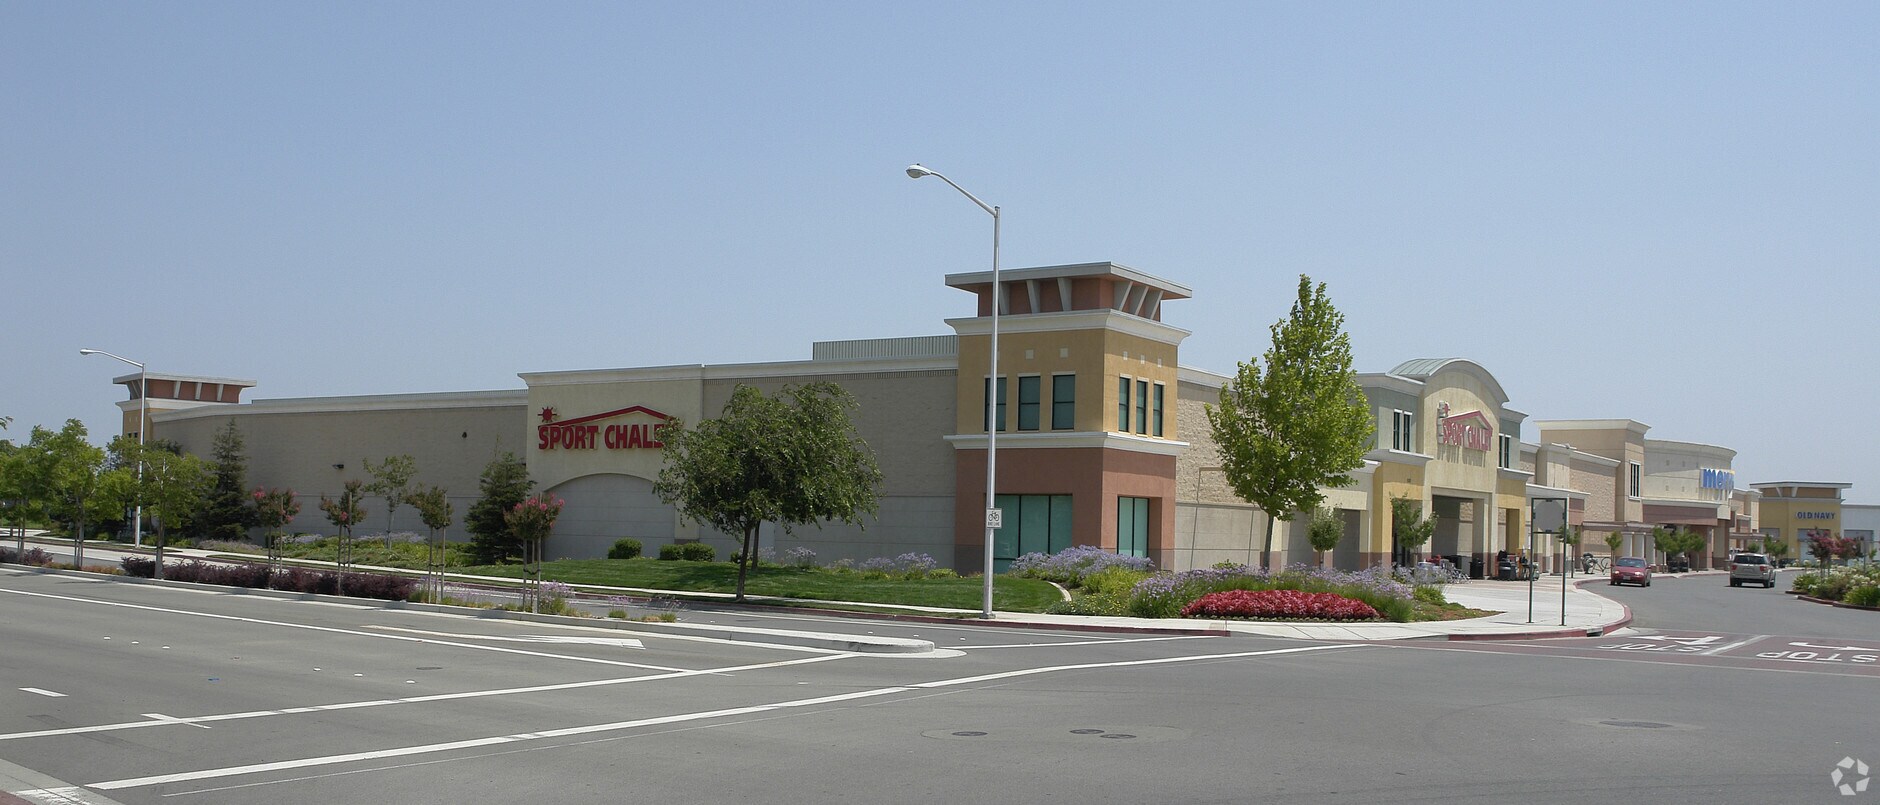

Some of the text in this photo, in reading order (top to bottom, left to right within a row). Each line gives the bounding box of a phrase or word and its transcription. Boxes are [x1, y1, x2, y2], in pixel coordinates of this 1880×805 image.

[538, 424, 666, 450] SPORT CHALE
[1797, 511, 1836, 519] OLD NAVY
[1756, 650, 1878, 662] STOP
